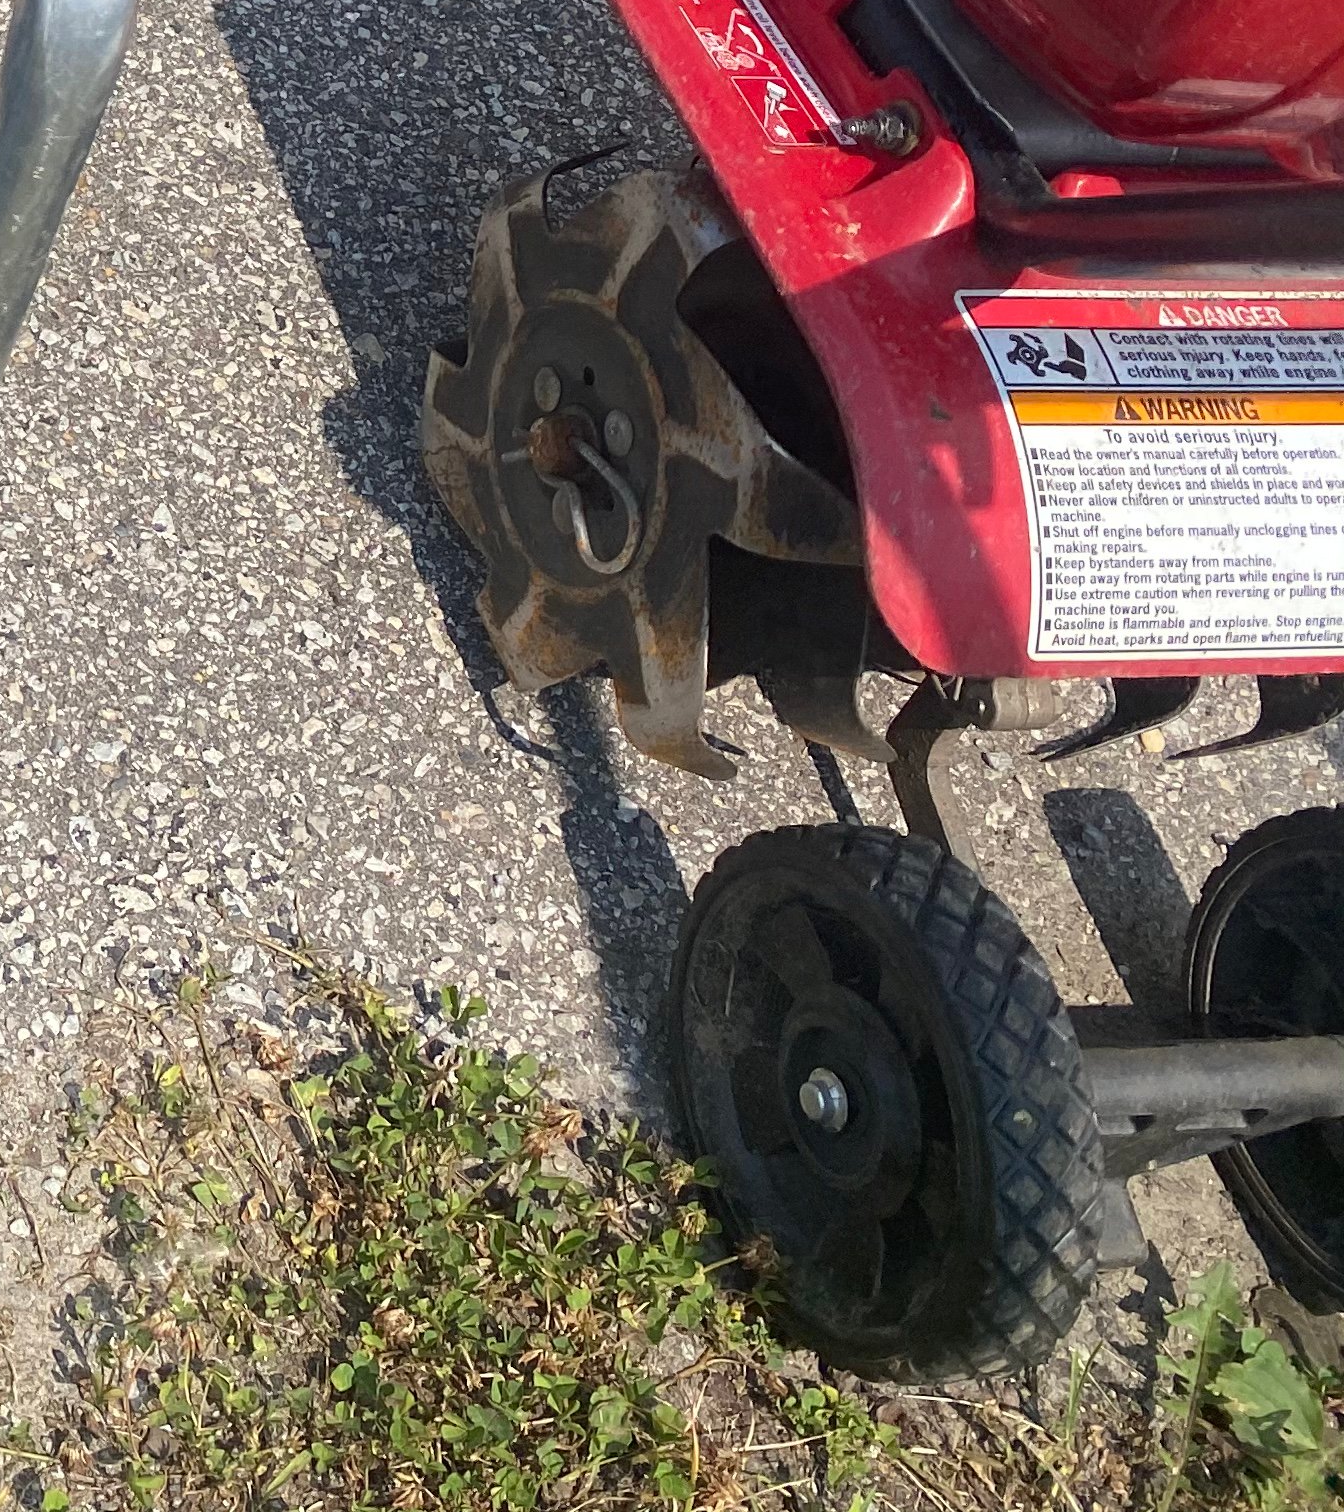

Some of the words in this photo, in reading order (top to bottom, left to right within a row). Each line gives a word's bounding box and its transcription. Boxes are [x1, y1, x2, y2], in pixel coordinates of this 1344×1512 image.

[1182, 305, 1290, 327] DANGER
[1109, 332, 1172, 346] Contact
[1174, 332, 1211, 345] with
[1212, 332, 1275, 348] rotating
[1118, 349, 1176, 361] serious
[1233, 349, 1274, 364] Keep
[1127, 365, 1192, 381] clothing
[1196, 368, 1235, 381] away
[1239, 365, 1280, 378] while
[1284, 365, 1337, 381] engine
[1140, 397, 1261, 421] WARNING
[1103, 429, 1122, 444] To
[1128, 429, 1170, 444] avoid
[1174, 429, 1231, 443] serious
[1039, 448, 1070, 460] Read
[1073, 448, 1093, 460] the
[1096, 448, 1140, 460] owner's
[1143, 448, 1186, 459] manual
[1189, 448, 1239, 462] carefully
[1241, 447, 1279, 459] before
[1283, 447, 1341, 461] operation.
[1043, 464, 1075, 476] Know
[1078, 464, 1125, 476] location
[1129, 464, 1150, 476] and
[1154, 464, 1207, 476] functions
[1211, 464, 1221, 475] of
[1226, 463, 1239, 475] all
[1046, 479, 1076, 493] Keep
[1081, 479, 1095, 491] all
[1098, 479, 1133, 493] safety
[1137, 478, 1181, 491] devices
[1186, 478, 1206, 490] and
[1210, 478, 1250, 490] shields
[1253, 478, 1262, 490] in
[1266, 477, 1298, 492] place
[1302, 477, 1322, 489] and
[1048, 495, 1084, 506] Never
[1088, 495, 1117, 506] allow
[1121, 494, 1169, 506] children
[1173, 497, 1184, 506] or
[1188, 493, 1260, 505] uninstructed
[1264, 493, 1298, 504] adults
[1301, 493, 1312, 504] to
[1052, 525, 1079, 537] Shut
[1083, 525, 1099, 537] off
[1103, 525, 1142, 539] engine
[1146, 524, 1184, 536] before
[1188, 524, 1240, 539] manually
[1244, 523, 1307, 537] unclogging
[1310, 522, 1338, 535] tines
[1054, 541, 1098, 555] making
[1055, 557, 1085, 571] Keep
[1089, 556, 1154, 571] bystanders
[1159, 558, 1188, 572] away
[1192, 556, 1219, 567] from
[1055, 573, 1085, 587] Keep
[1090, 574, 1120, 587] away
[1124, 572, 1151, 584] from
[1156, 572, 1201, 585] rotating
[1205, 572, 1235, 585] parts
[1239, 571, 1267, 582] while
[1272, 569, 1310, 584] engine
[1313, 568, 1322, 581] is
[1055, 588, 1076, 600] Use
[1081, 589, 1130, 599] extreme
[1135, 587, 1177, 599] caution
[1182, 587, 1212, 598] when
[1215, 586, 1270, 599] reversing
[1274, 588, 1285, 597] or
[1289, 585, 1327, 599] pulling
[1054, 603, 1106, 615] machine
[1110, 602, 1150, 615] toward
[1054, 618, 1105, 630] Gasoline
[1109, 618, 1118, 629] is
[1123, 617, 1185, 629] flammable
[1189, 616, 1210, 628] and
[1276, 614, 1302, 629] Stop
[1052, 634, 1085, 646] Avoid
[1124, 633, 1162, 647] sparks
[1167, 632, 1189, 644] and
[1192, 635, 1221, 646] open
[1225, 632, 1257, 643] flame
[1262, 631, 1291, 642] when
